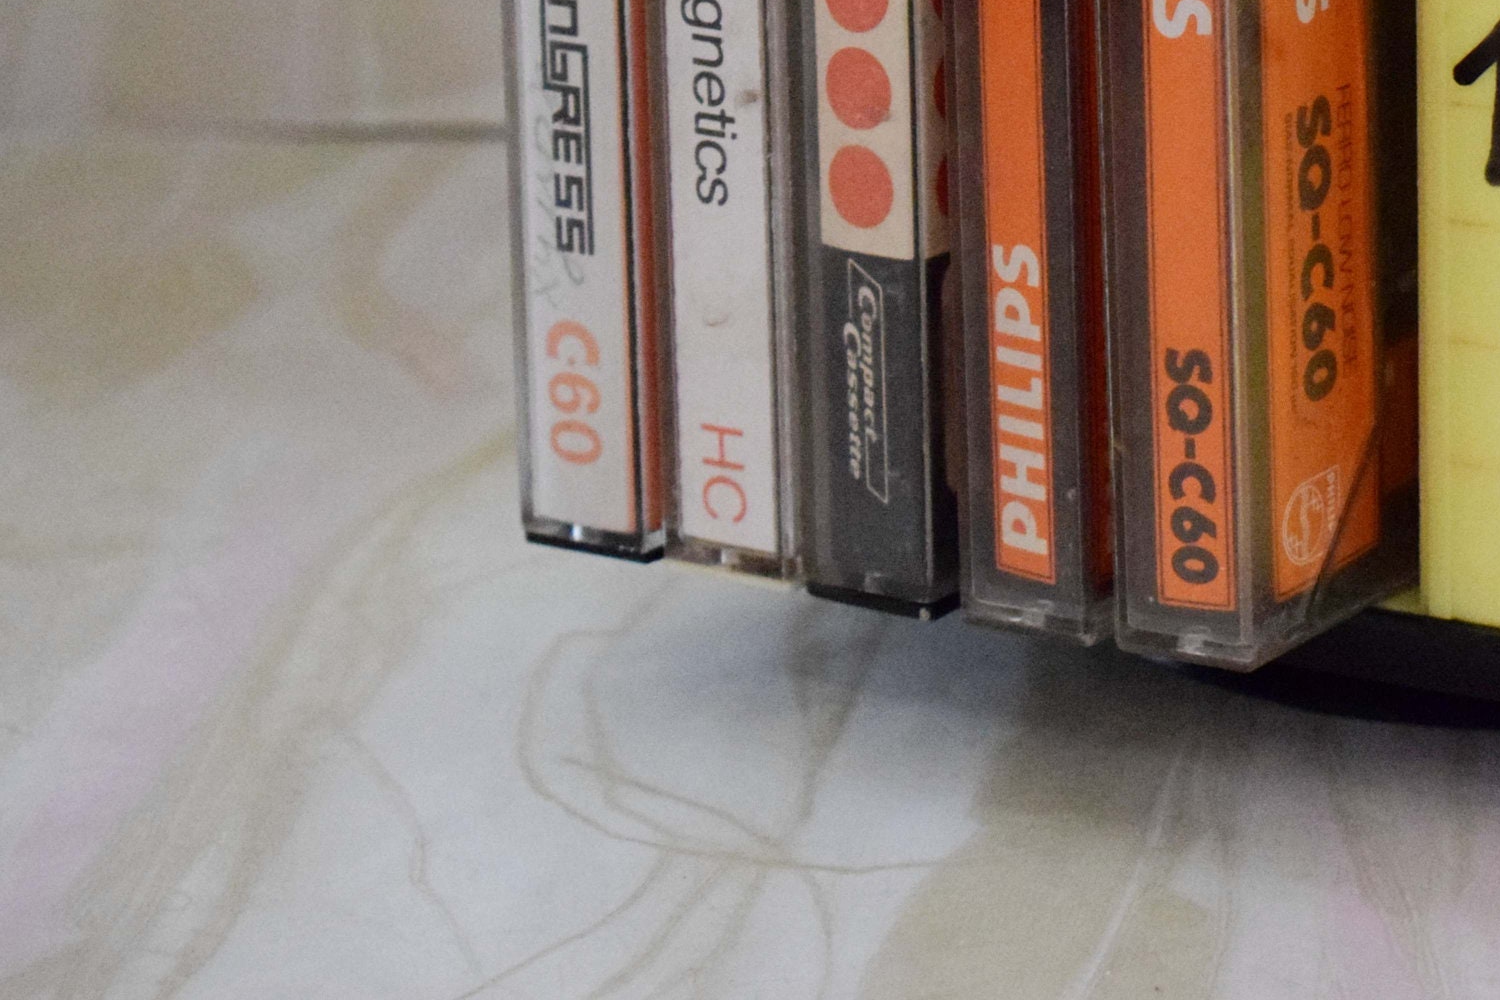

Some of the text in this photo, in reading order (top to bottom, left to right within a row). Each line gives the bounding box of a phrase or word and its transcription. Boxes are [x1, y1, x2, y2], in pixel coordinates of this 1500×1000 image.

[843, 322, 863, 479] Cassette
[858, 286, 878, 443] Compact
[992, 244, 1048, 555] PHILIPS
[701, 423, 747, 524] HC
